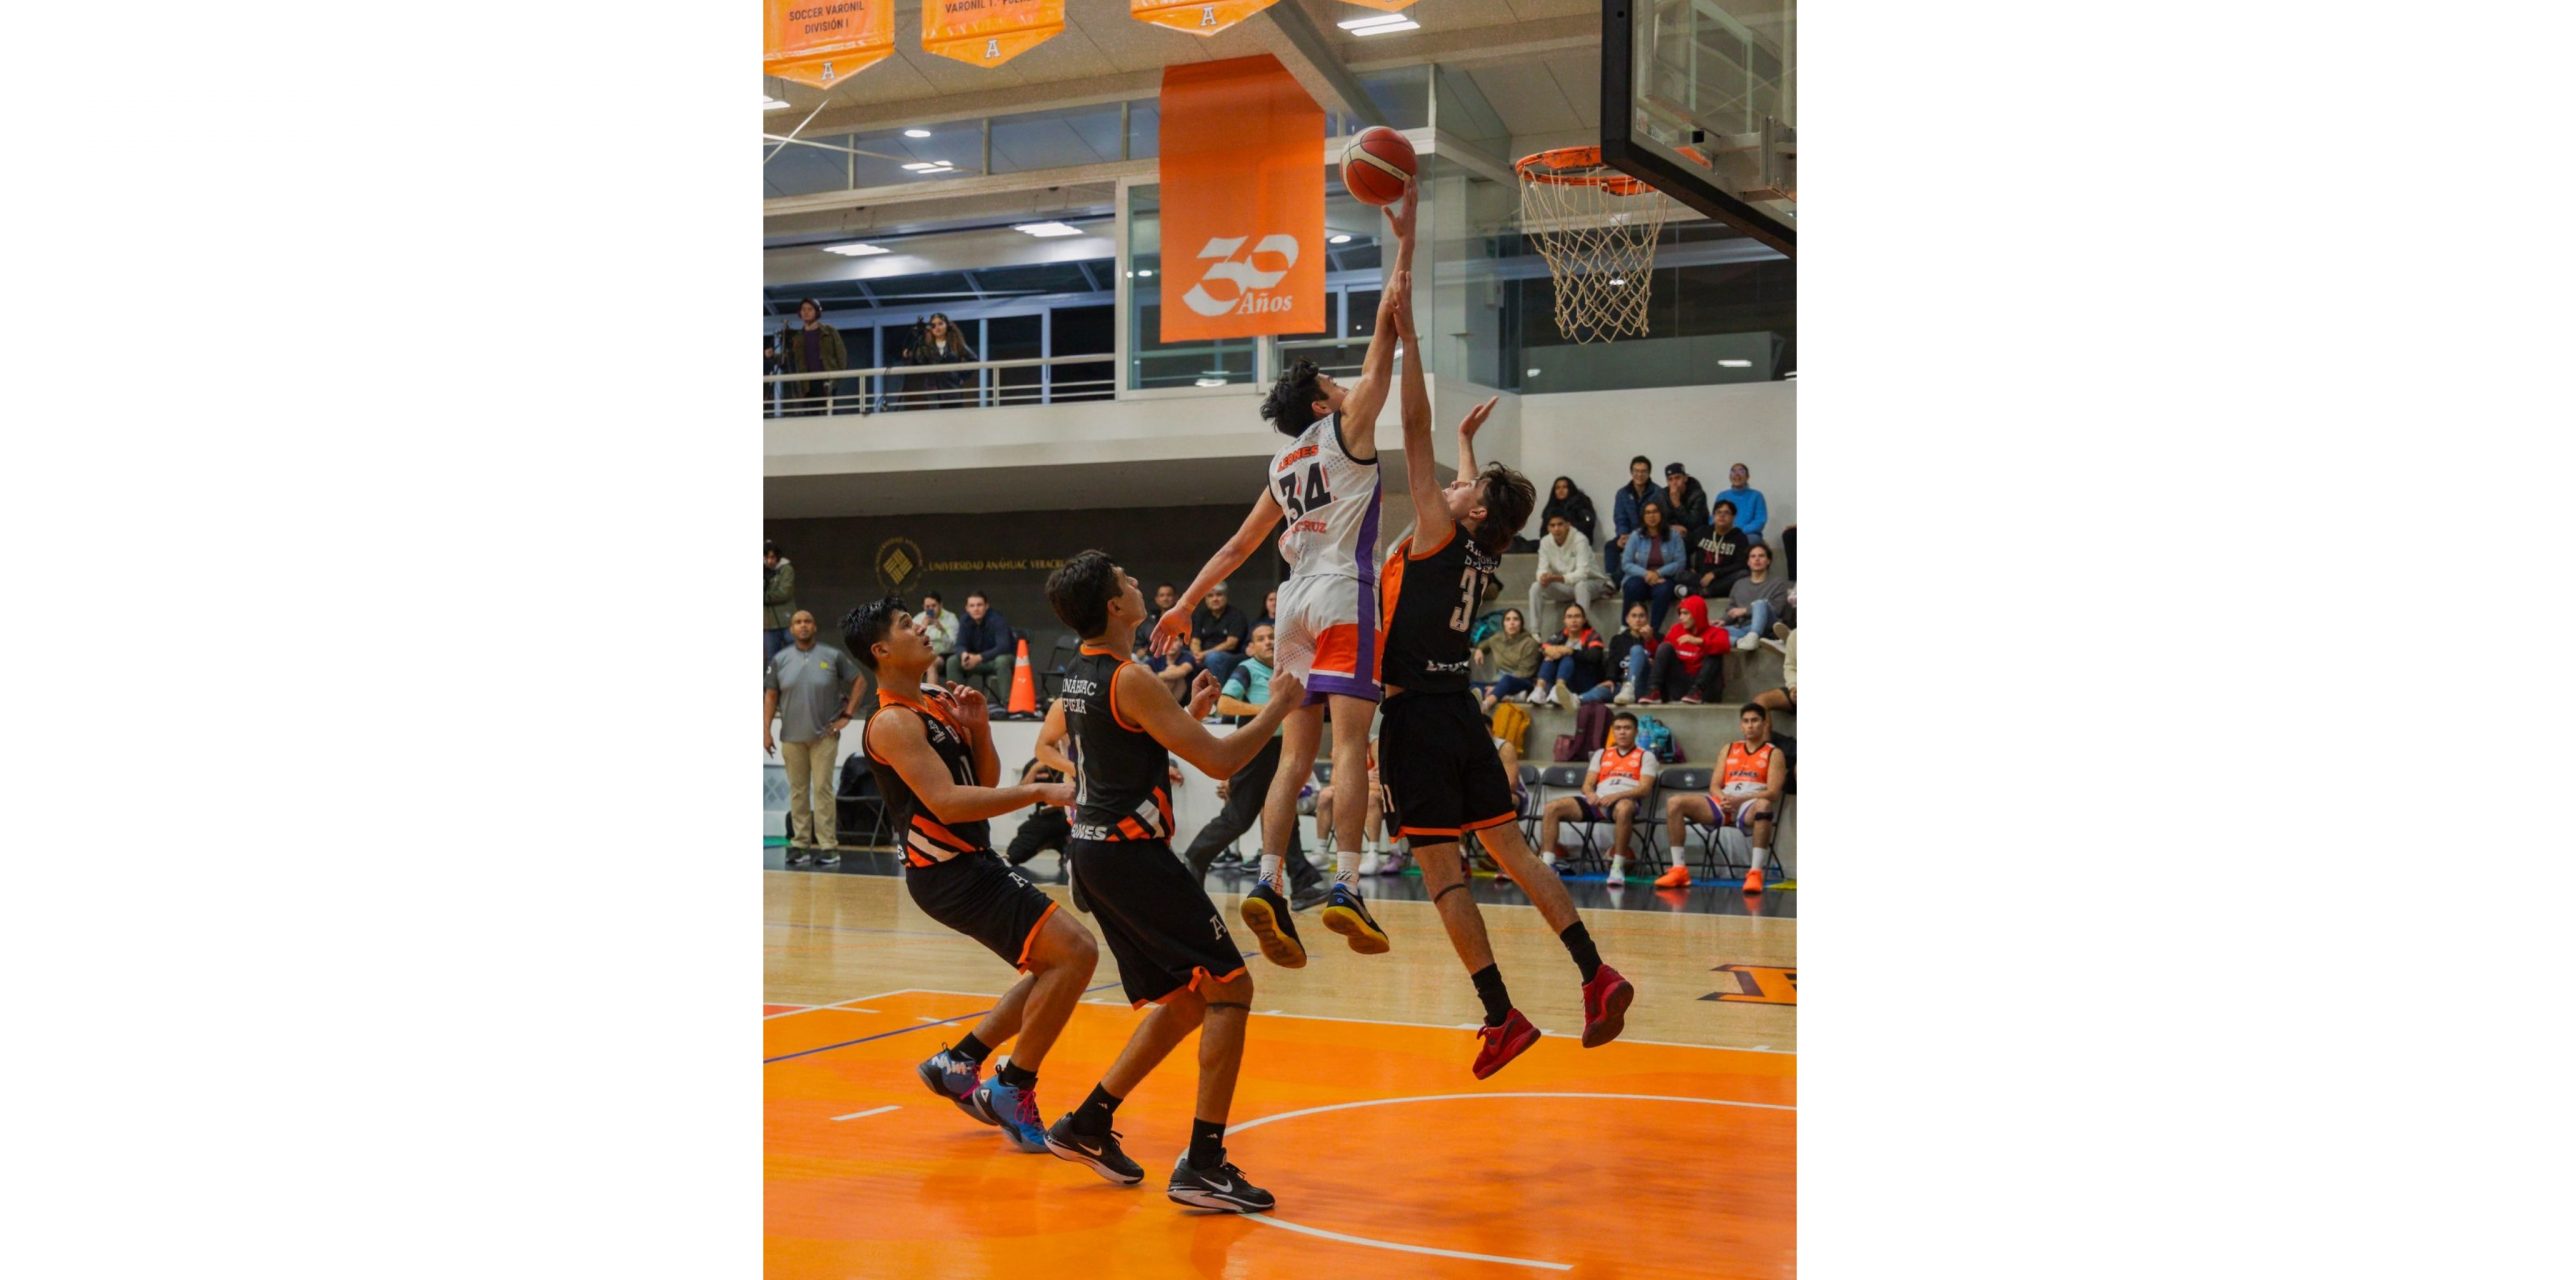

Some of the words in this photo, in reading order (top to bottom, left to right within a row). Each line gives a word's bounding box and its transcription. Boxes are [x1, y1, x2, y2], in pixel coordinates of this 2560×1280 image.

[789, 7, 823, 21] SOCCER
[826, 1, 864, 16] VARONIL
[945, 0, 985, 13] VARONIL
[1201, 7, 1216, 26] A
[804, 19, 843, 34] DIVISIÓN
[986, 40, 1000, 58] A
[822, 62, 835, 80] A
[1182, 234, 1299, 316] 30
[1236, 292, 1293, 315] Años
[1277, 444, 1319, 472] LEONES
[1278, 462, 1332, 527] 34
[929, 561, 983, 571] UNIVERSIDAD
[986, 559, 1026, 570] ANÁHUAC
[1210, 914, 1227, 940] A
